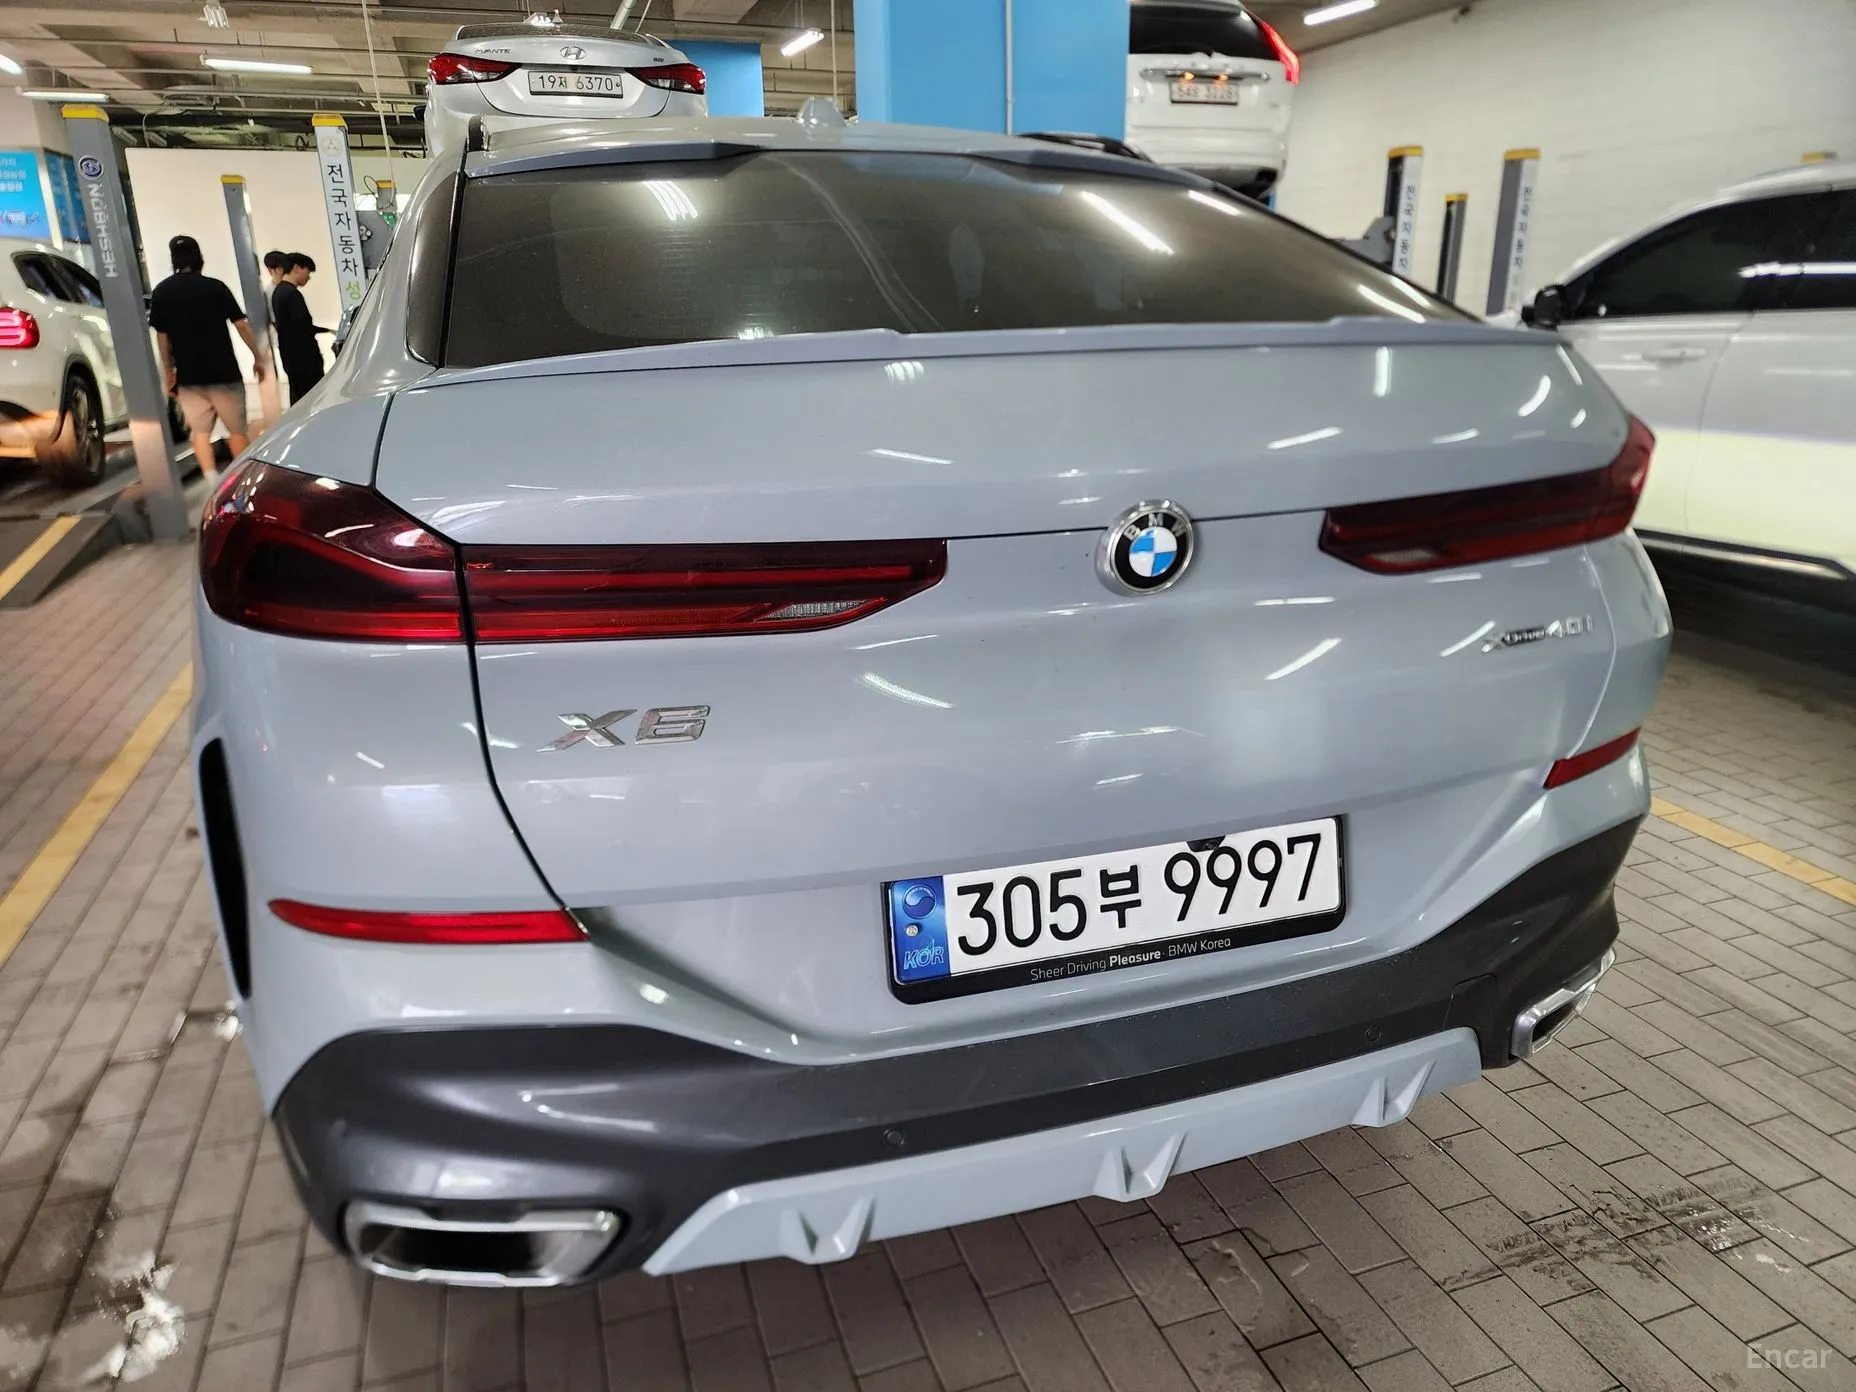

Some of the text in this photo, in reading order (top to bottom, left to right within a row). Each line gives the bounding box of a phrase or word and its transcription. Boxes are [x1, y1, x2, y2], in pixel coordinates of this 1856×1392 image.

[576, 77, 614, 91] 6370
[87, 183, 118, 278] HESHBON
[1123, 512, 1187, 540] BMW
[536, 705, 711, 753] X6
[956, 832, 1322, 957] 305부 9997
[903, 945, 945, 970] KOR
[1030, 937, 1231, 981] Sheer Driving Pleasure BMW Korea
